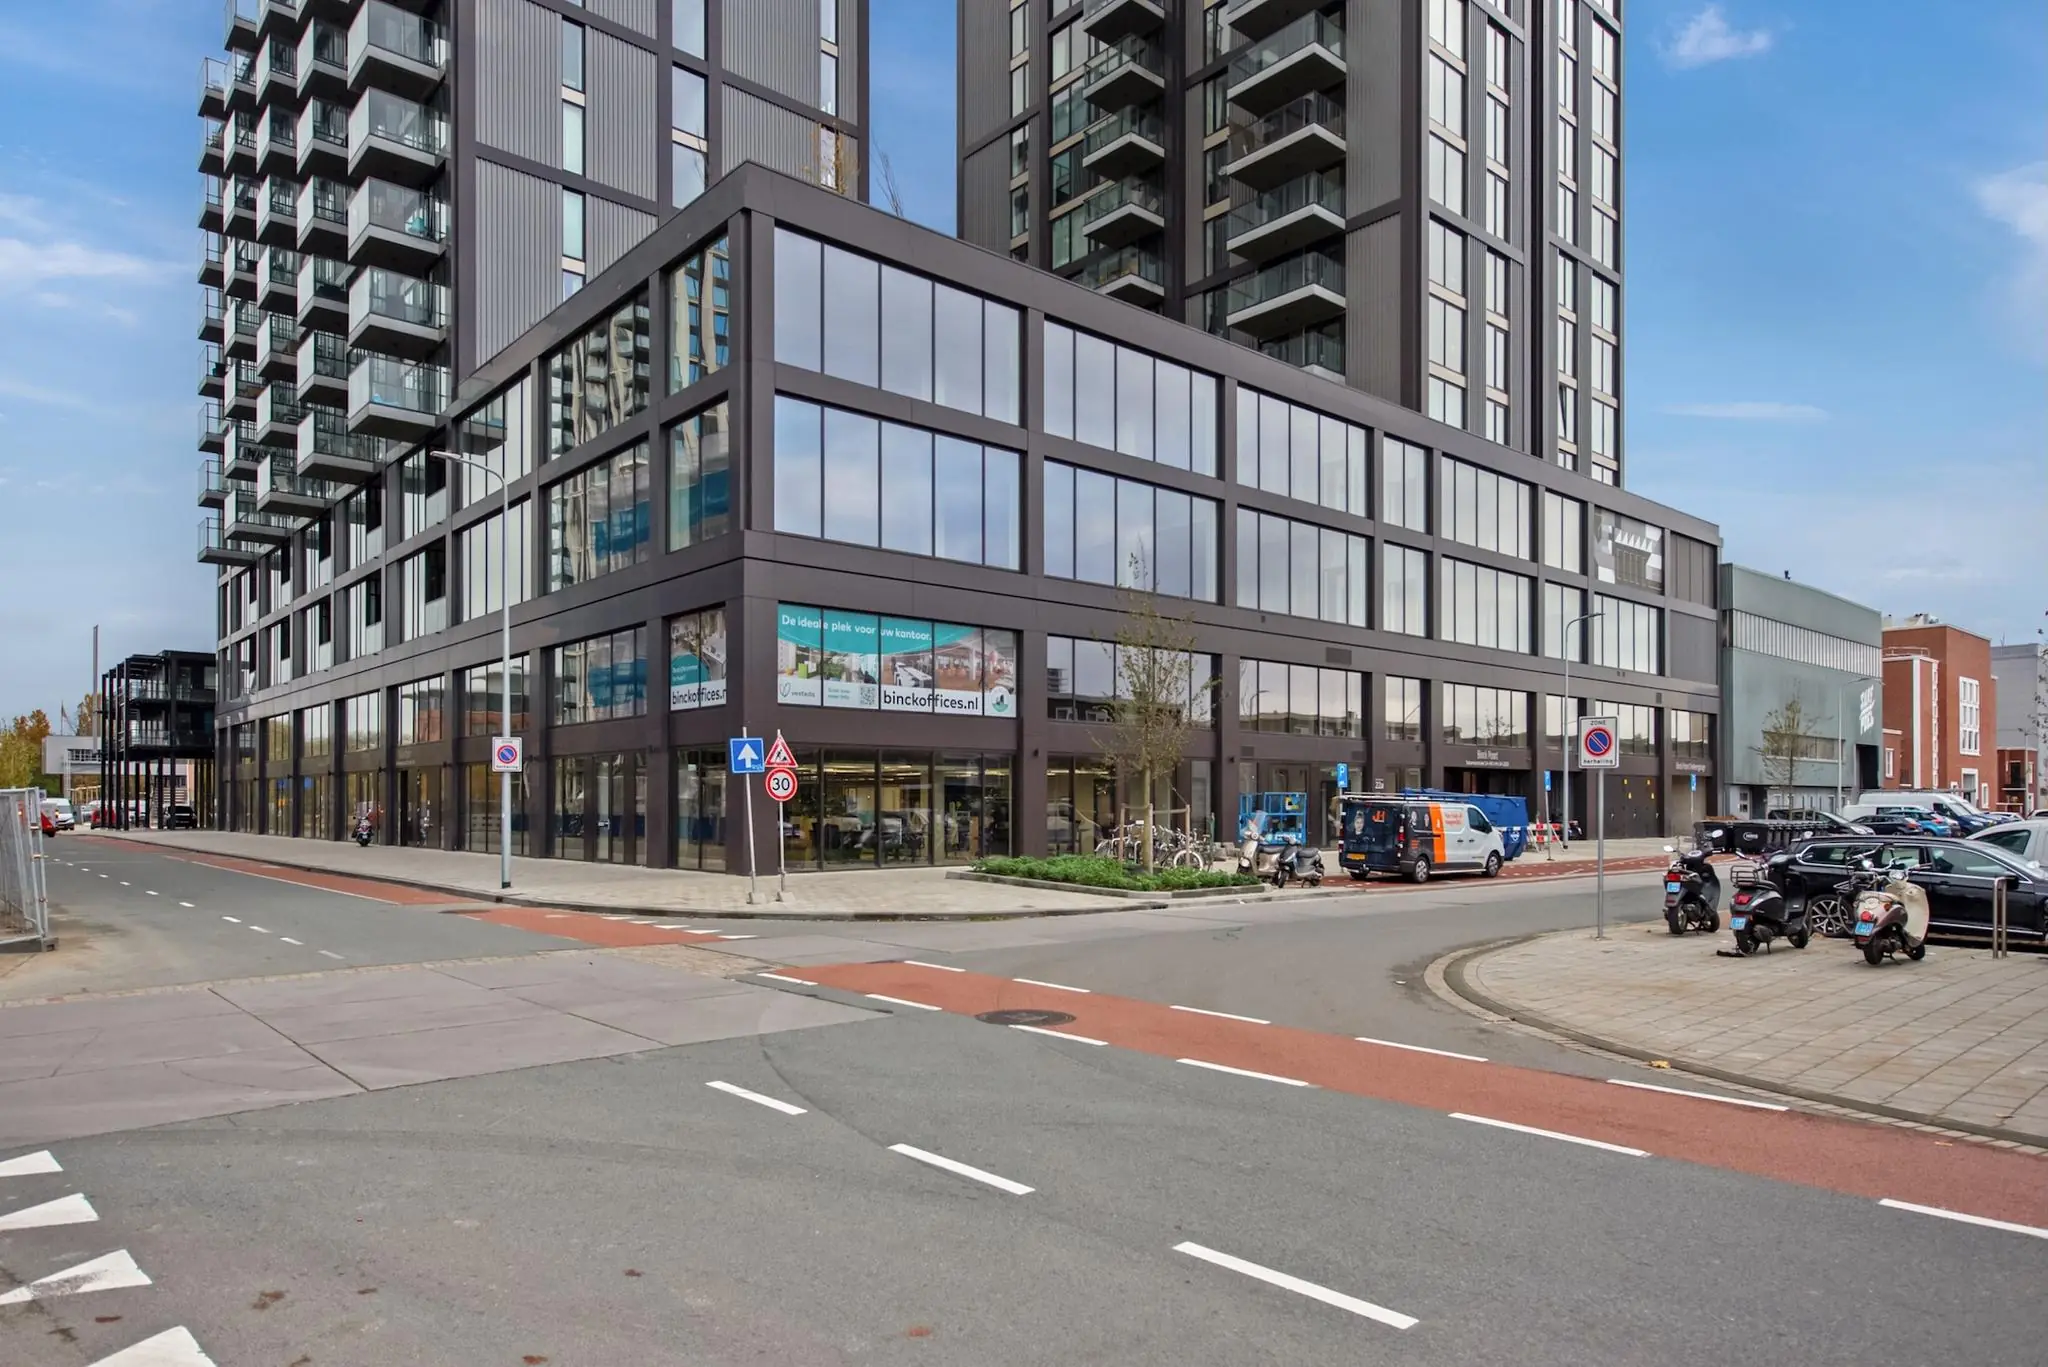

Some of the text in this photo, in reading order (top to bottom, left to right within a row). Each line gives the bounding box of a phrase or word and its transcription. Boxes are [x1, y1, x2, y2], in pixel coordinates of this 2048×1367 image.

[782, 614, 932, 641] De ideale plek voor uw kantoor.
[672, 687, 727, 704] binckoffices.n
[883, 690, 979, 710] binckoffices.nl
[772, 777, 790, 791] 30
